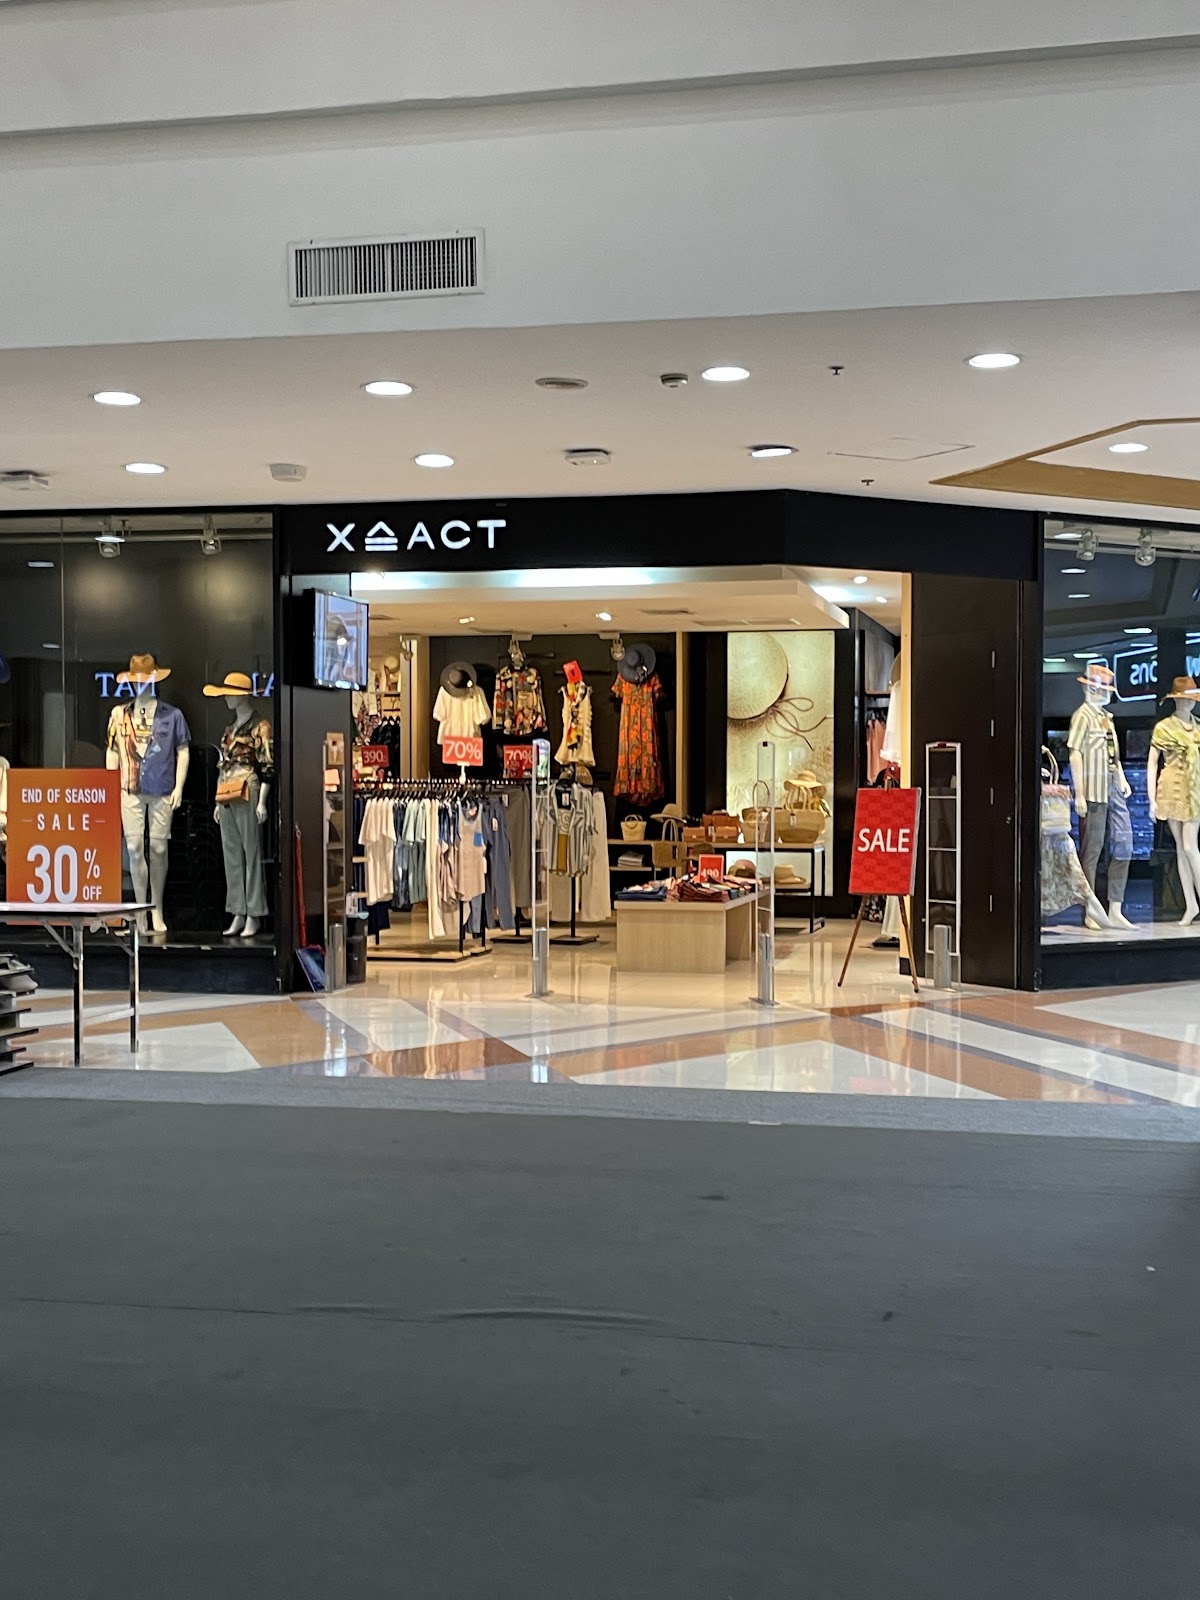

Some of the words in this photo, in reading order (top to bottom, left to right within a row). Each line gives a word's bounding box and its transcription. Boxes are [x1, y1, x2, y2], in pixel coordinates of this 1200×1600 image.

[444, 739, 481, 760] 70%
[21, 788, 42, 803] END
[47, 788, 61, 803] OF
[65, 788, 106, 803] SEASON
[37, 813, 90, 831] SALE
[857, 828, 911, 853] SALE
[82, 885, 102, 901] OFF
